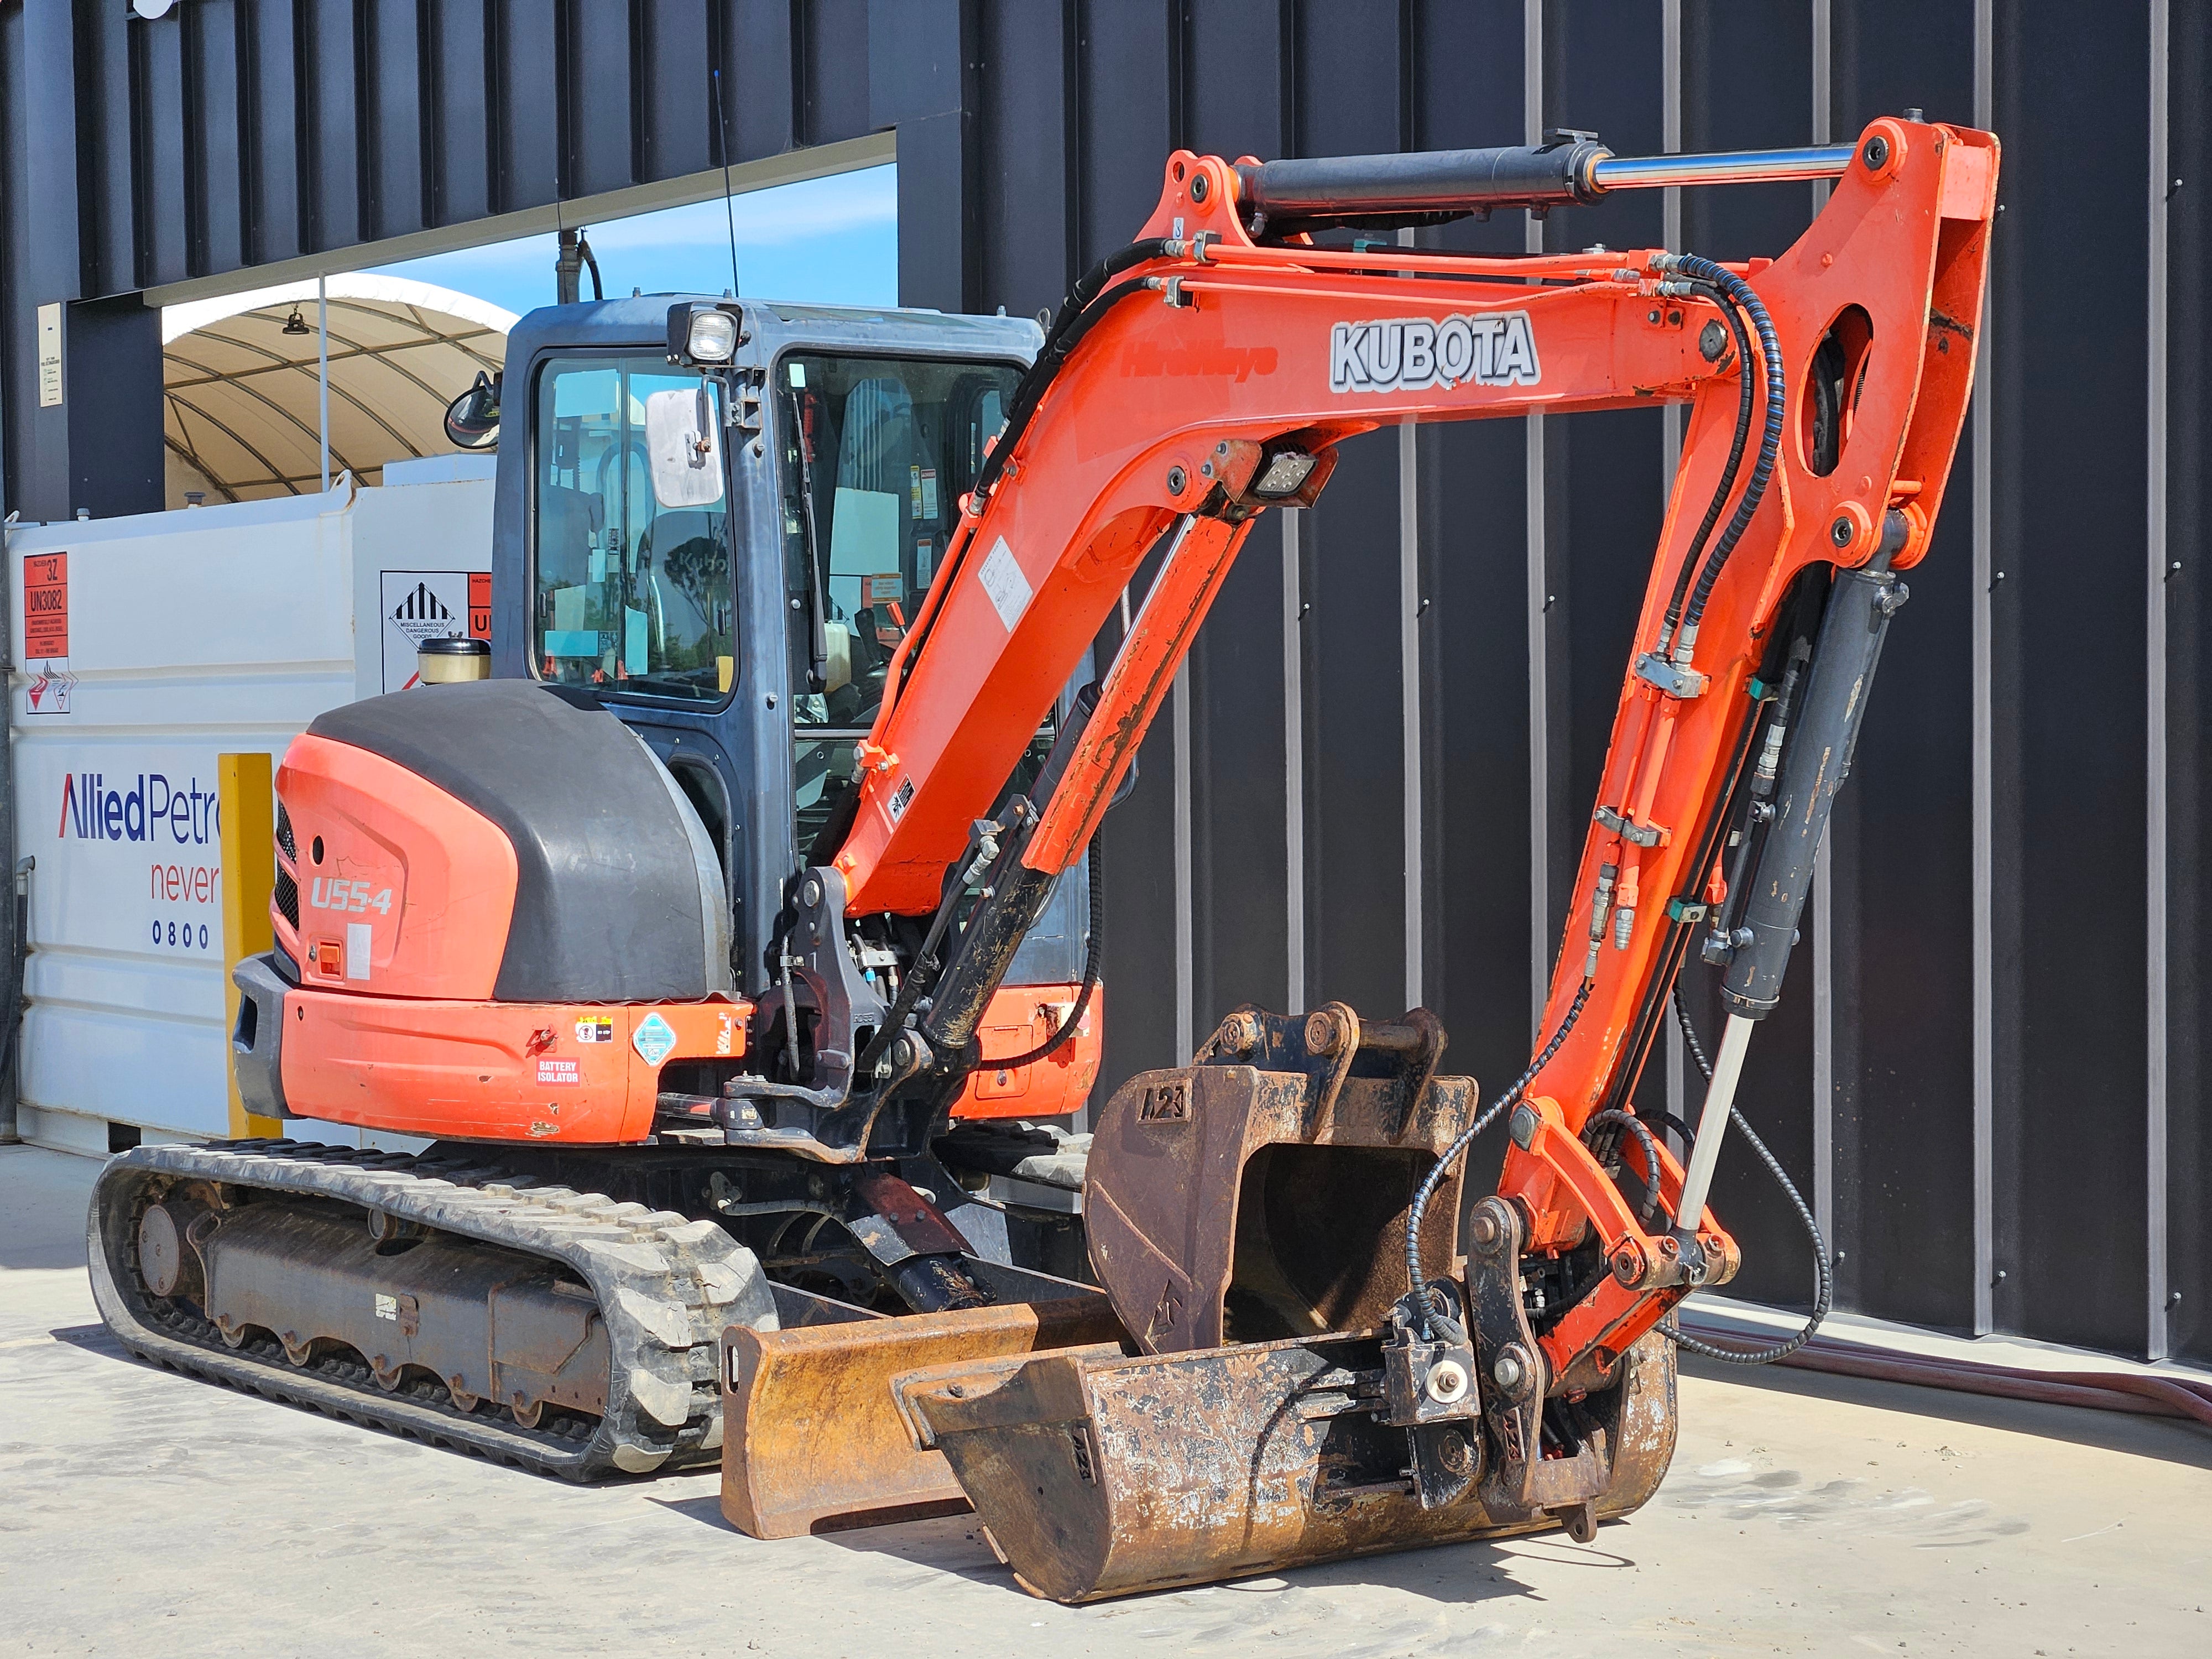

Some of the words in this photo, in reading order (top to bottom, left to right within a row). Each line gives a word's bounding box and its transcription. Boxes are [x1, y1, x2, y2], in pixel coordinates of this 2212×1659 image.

[1334, 317, 1534, 383] KUBOTA
[46, 559, 58, 581] 3Z
[30, 589, 62, 612] UN3082
[475, 615, 491, 631] U
[59, 773, 221, 844] AlliedPetr
[152, 864, 220, 903] never
[538, 1072, 578, 1082] ISOLATOR
[539, 1061, 576, 1071] BATTERY
